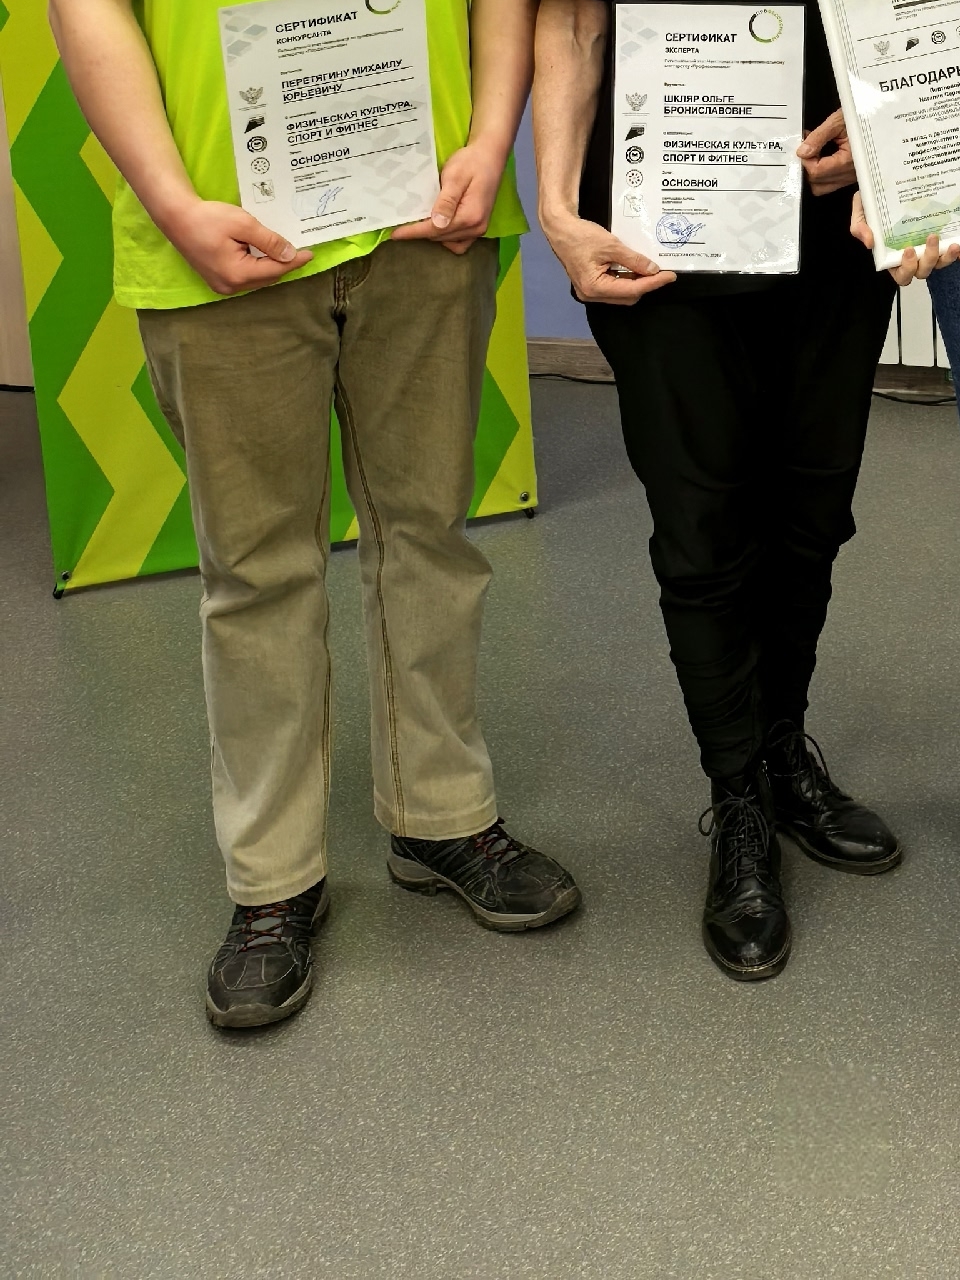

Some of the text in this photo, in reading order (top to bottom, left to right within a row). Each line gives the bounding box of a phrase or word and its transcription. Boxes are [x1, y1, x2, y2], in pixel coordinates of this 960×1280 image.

[275, 10, 358, 33] СЕРТИФИКАТ
[276, 30, 332, 45] КОНКУРСАНТА
[665, 32, 737, 43] СЕРТИФИКАТ
[281, 68, 350, 89] ПЕРЕТЯГИНУ
[352, 59, 403, 75] МИХАИЛУ
[283, 83, 343, 102] ЮРЬЕВИЧУ
[664, 95, 735, 103] ШКЛЯР ОЛЬГЕ
[663, 106, 752, 115] БРОНИСЛАВОВНЕ
[286, 110, 358, 131] ФИЗИЧЕСКАЯ
[287, 118, 379, 144] СПОРТ И ФИТНЕС
[663, 140, 730, 150] ФИЗИЧЕСКАЯ
[290, 146, 350, 167] ОСНОВНОЙ
[662, 153, 697, 162] СПОРТ
[708, 154, 748, 163] ФИТНЕС
[661, 177, 718, 187] ОСНОВНОЙ
